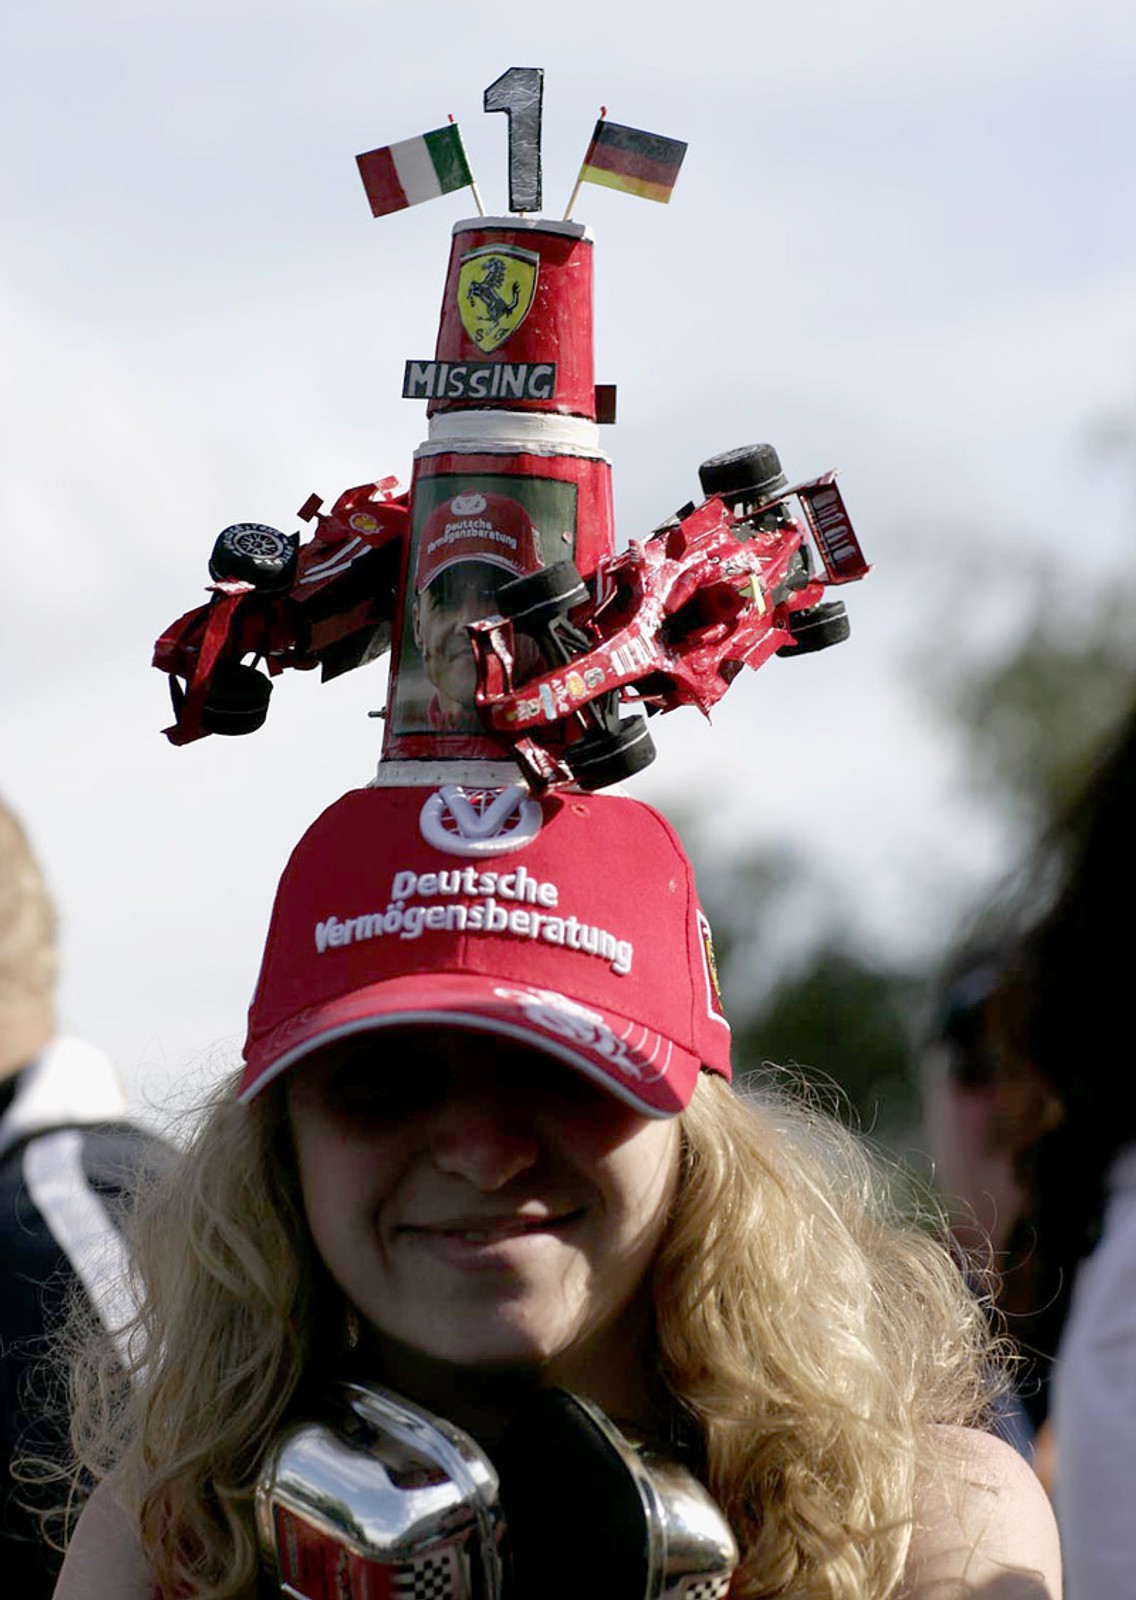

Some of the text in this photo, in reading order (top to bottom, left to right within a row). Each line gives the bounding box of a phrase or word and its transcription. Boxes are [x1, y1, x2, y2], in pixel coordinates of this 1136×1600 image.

[483, 66, 544, 213] 1
[407, 363, 553, 398] MISSING
[391, 866, 559, 908] Deutsche
[315, 898, 633, 976] Vermögensberatung
